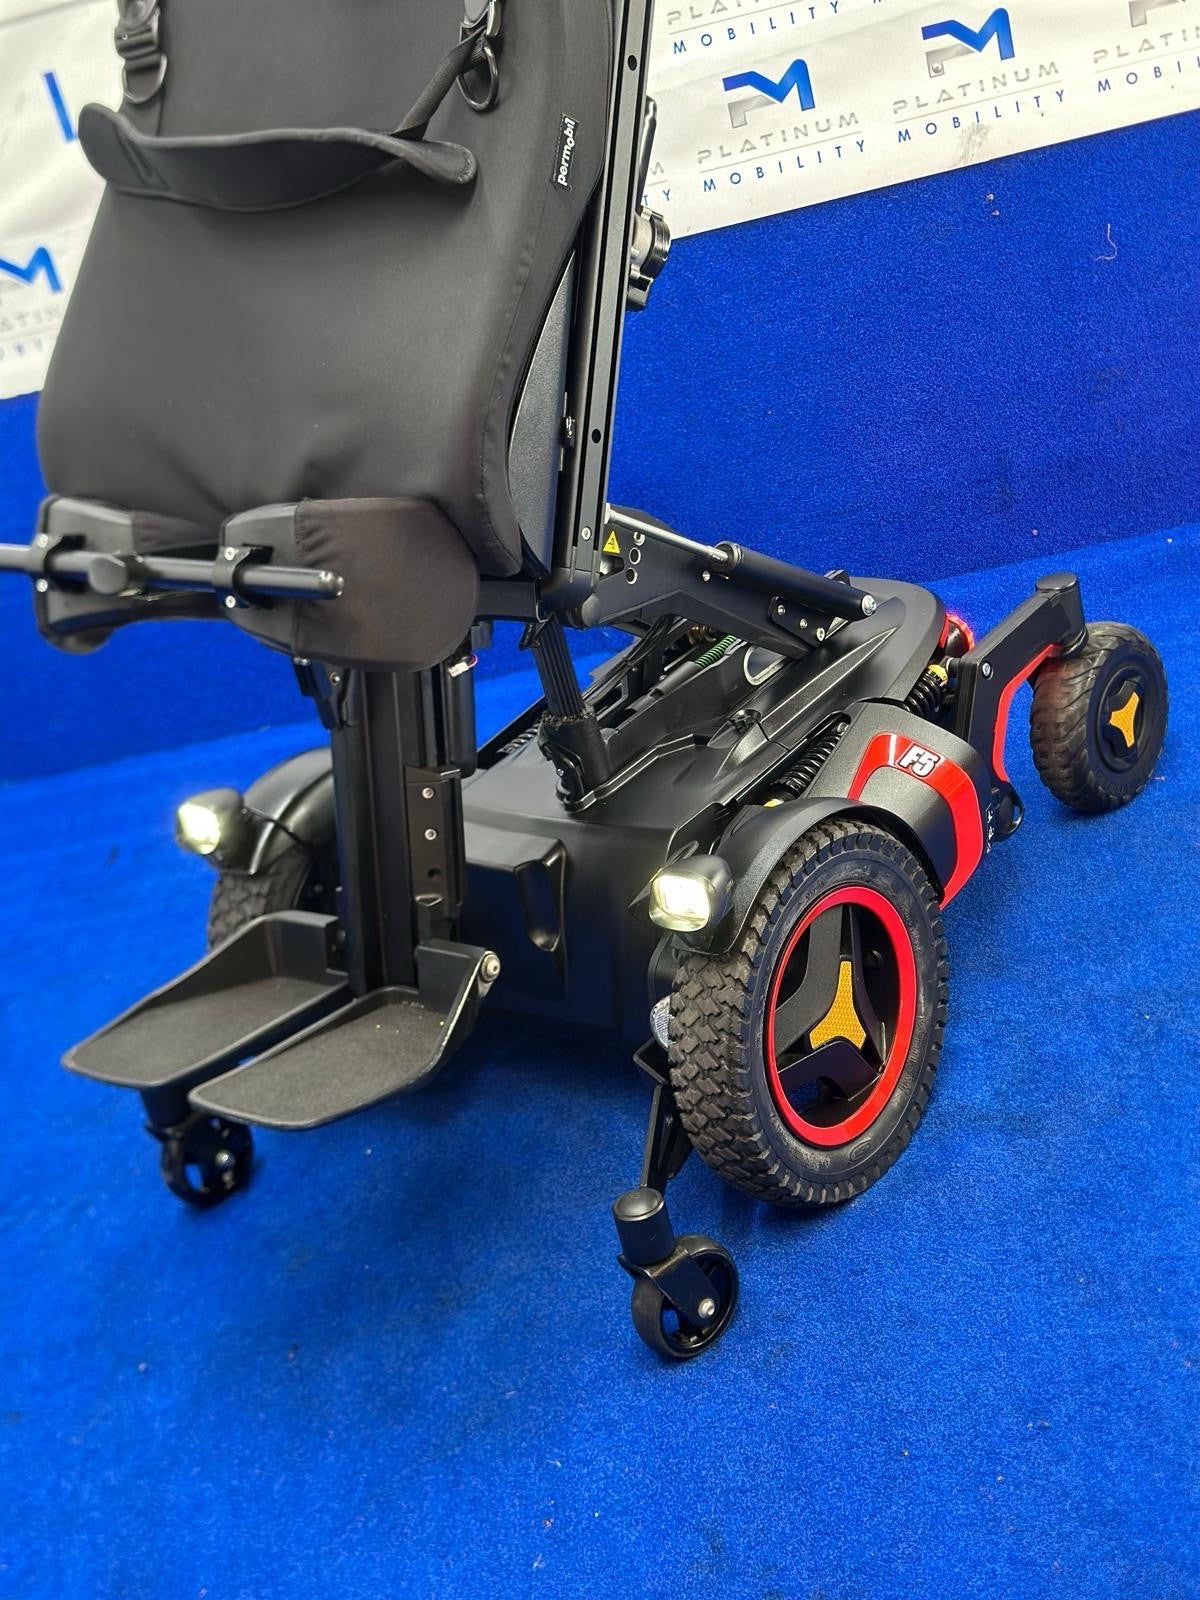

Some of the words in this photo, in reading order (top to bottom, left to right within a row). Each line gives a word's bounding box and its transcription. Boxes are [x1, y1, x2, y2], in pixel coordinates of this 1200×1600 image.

[673, 1, 838, 54] MOBILITY
[892, 61, 1059, 114] PLATINUM
[697, 112, 859, 164] PLATINUM
[898, 89, 1064, 143] MOBILITY
[557, 117, 576, 187] permobil
[703, 140, 865, 192] MOBILITY
[898, 743, 942, 778] F5
